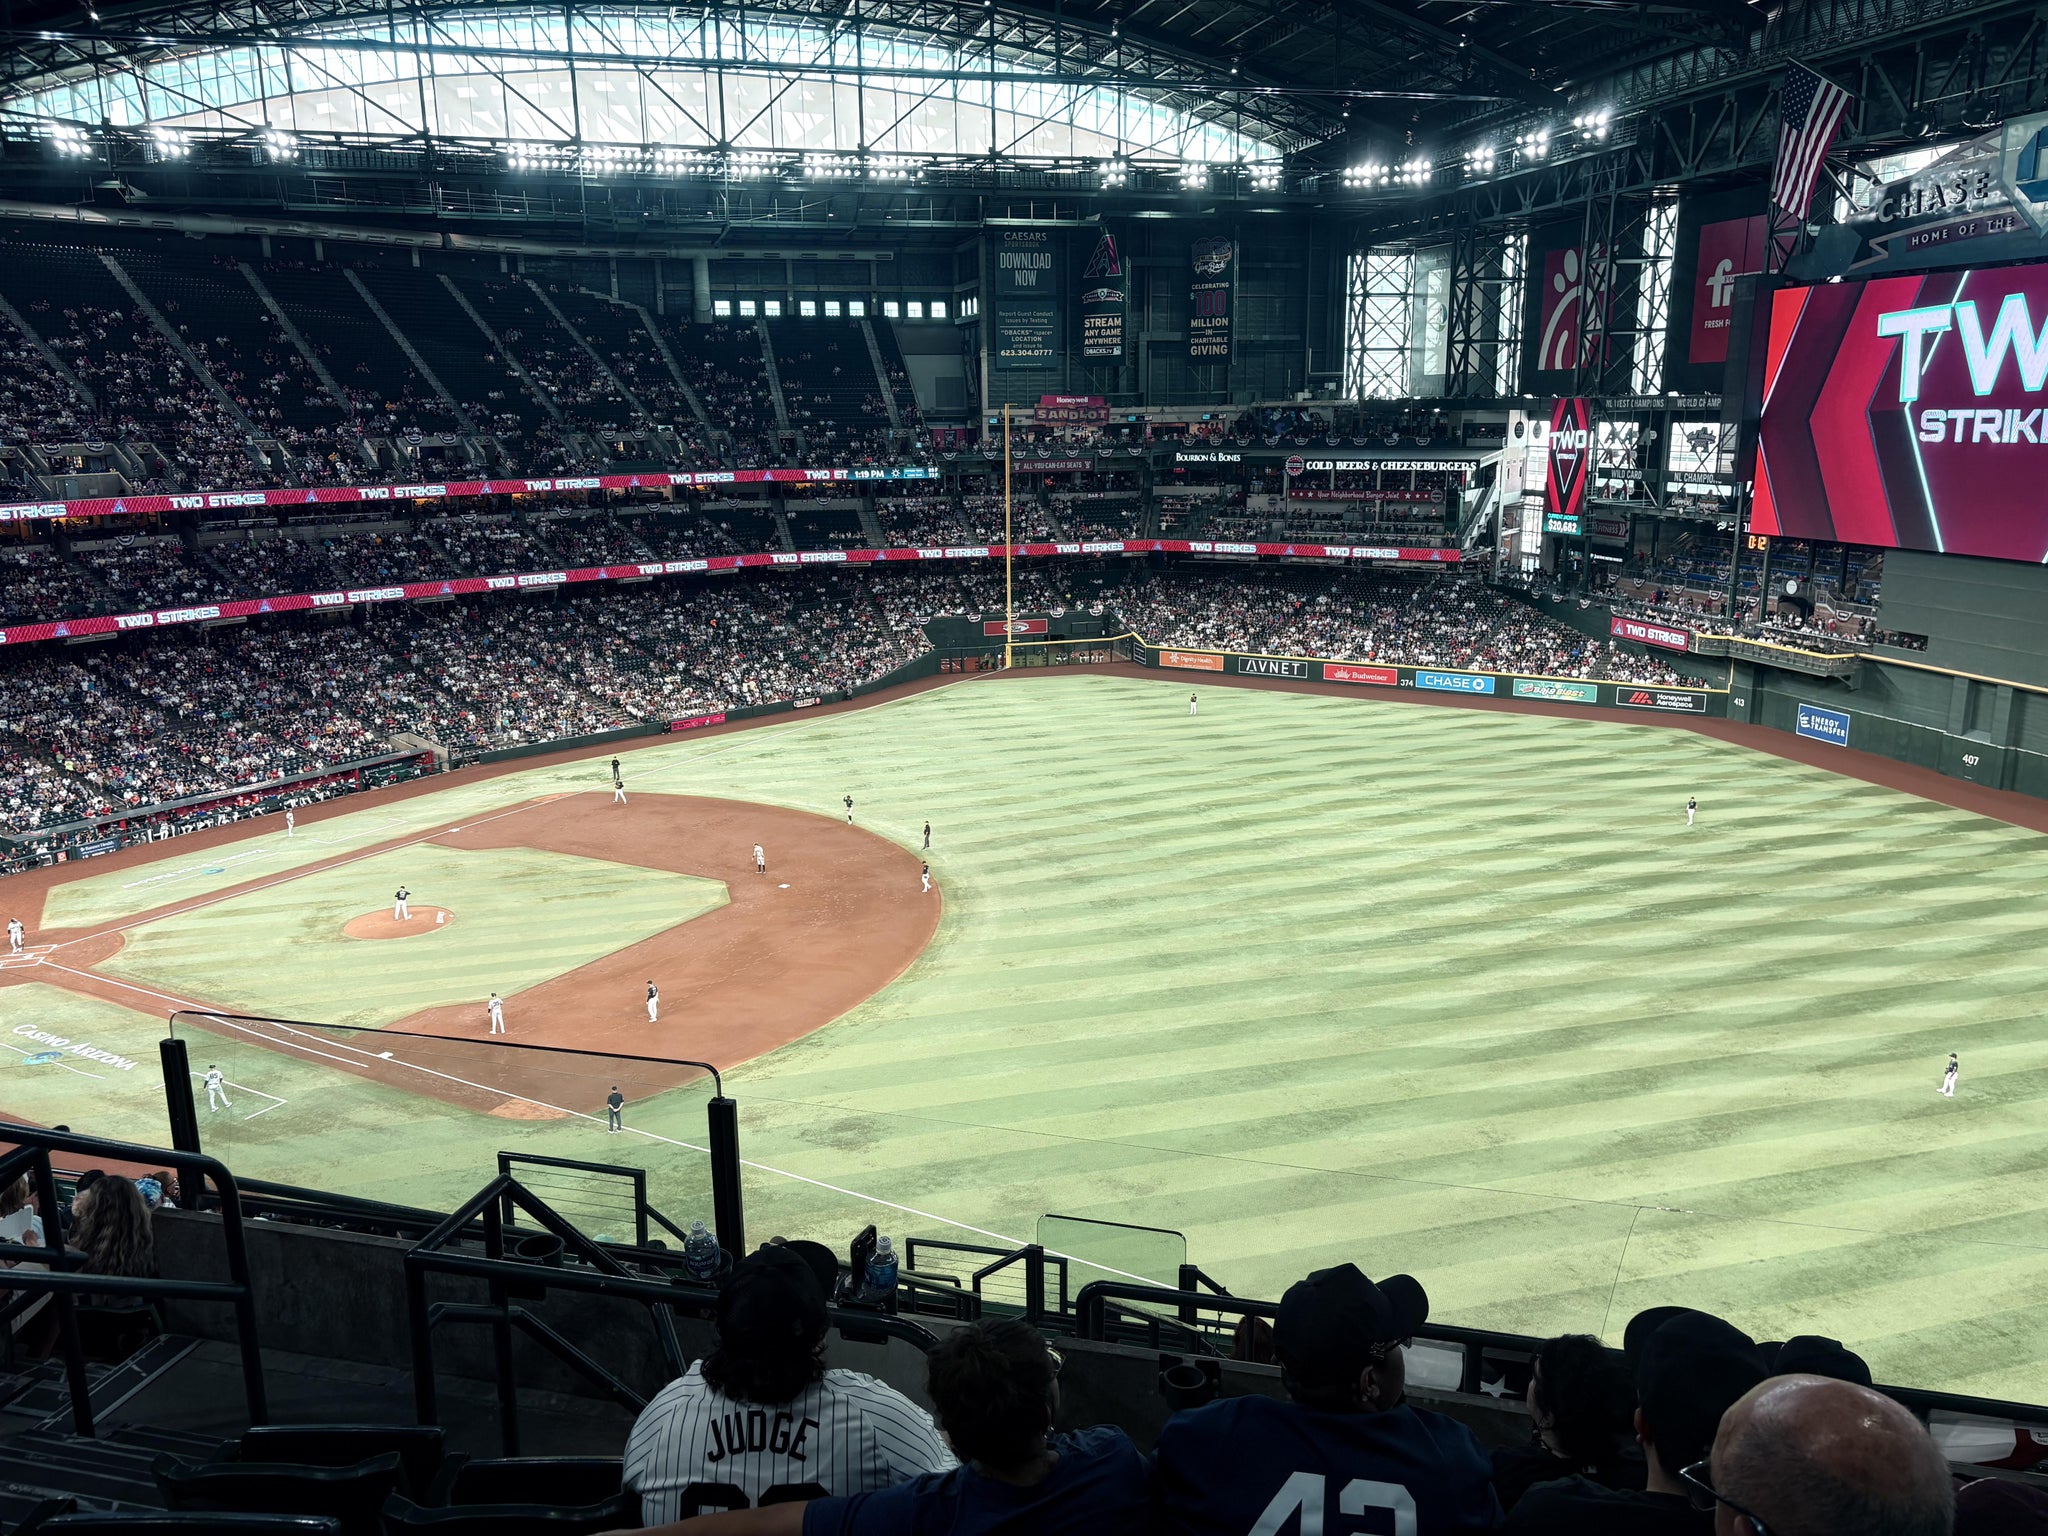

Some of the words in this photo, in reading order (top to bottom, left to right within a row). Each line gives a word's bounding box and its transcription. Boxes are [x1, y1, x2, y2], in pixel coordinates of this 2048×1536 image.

[1877, 172, 1990, 224] CHASE
[1003, 232, 1047, 241] CAESARS
[1911, 229, 1949, 247] HOME
[1959, 224, 1976, 236] OF
[1986, 217, 2015, 232] THE
[1000, 253, 1051, 269] DOWNLOAD
[1015, 270, 1037, 286] NOW
[1192, 282, 1229, 290] CELEBRATING
[1084, 318, 1121, 328] STREAM
[1190, 317, 1229, 328] MILLION
[1084, 329, 1099, 337] ANY
[1100, 328, 1121, 336] GAME
[1084, 337, 1121, 345] ANYWHERE
[1190, 336, 1228, 344] CHARITABLE
[1001, 349, 1053, 357] 623.304.0777
[1190, 345, 1228, 356] GIVING
[1056, 397, 1089, 405] Honeywell
[1037, 410, 1107, 420] SANDLOT
[1919, 408, 2048, 445] STRIK
[1549, 430, 1587, 450] TWO
[1209, 453, 1217, 462] &
[1306, 461, 1334, 471] COLD
[1335, 461, 1371, 471] BEERS
[1372, 461, 1379, 470] &
[1381, 461, 1477, 472] CHEESEBURGERS
[668, 474, 692, 484] TWO
[695, 473, 735, 483] STRIKES
[804, 470, 830, 480] TWO
[854, 470, 870, 479] 1:19
[871, 470, 885, 478] PM
[1611, 470, 1626, 479] WILD
[1626, 471, 1643, 479] CARD
[1673, 473, 1682, 481] NL
[1683, 473, 1722, 484] CHAMPIO
[524, 480, 552, 491] TWO
[556, 478, 600, 489] STRIKES
[358, 488, 390, 499] TWO
[394, 485, 447, 498] STRIKES
[169, 496, 204, 509] TWO
[209, 494, 266, 507] STRIKES
[1547, 520, 1577, 534] $20,682
[916, 549, 942, 559] TWO
[945, 547, 988, 557] STRIKES
[1055, 544, 1080, 553] TWO
[1082, 542, 1125, 552] STRIKES
[1188, 542, 1212, 552] TWO
[1215, 543, 1257, 553] STRIKES
[1324, 546, 1350, 556] TWO
[1352, 548, 1399, 558] STRIKES
[770, 554, 798, 563] TWO
[801, 552, 847, 562] STRIKES
[637, 564, 663, 575] TWO
[666, 560, 708, 572] STRIKES
[486, 577, 515, 589] TWO
[518, 573, 567, 586] STRIKES
[310, 592, 345, 606] TWO
[348, 588, 404, 602] STRIKES
[114, 613, 154, 628] TWO
[158, 607, 220, 623] STRIKES
[1626, 624, 1647, 638] TWO
[1647, 629, 1685, 646] STRIKES
[1246, 659, 1301, 675] AVNET
[1352, 672, 1388, 682] Budweiser
[1425, 675, 1470, 689] CHASE
[1400, 679, 1414, 687] 374
[1656, 693, 1692, 703] Honeywell
[1733, 697, 1745, 707] 413
[1655, 699, 1693, 709] Aerospace
[1810, 715, 1840, 729] ENERGY
[1810, 723, 1846, 738] TRANSFER
[1962, 753, 1979, 766] 407
[706, 1409, 821, 1463] JUDGE
